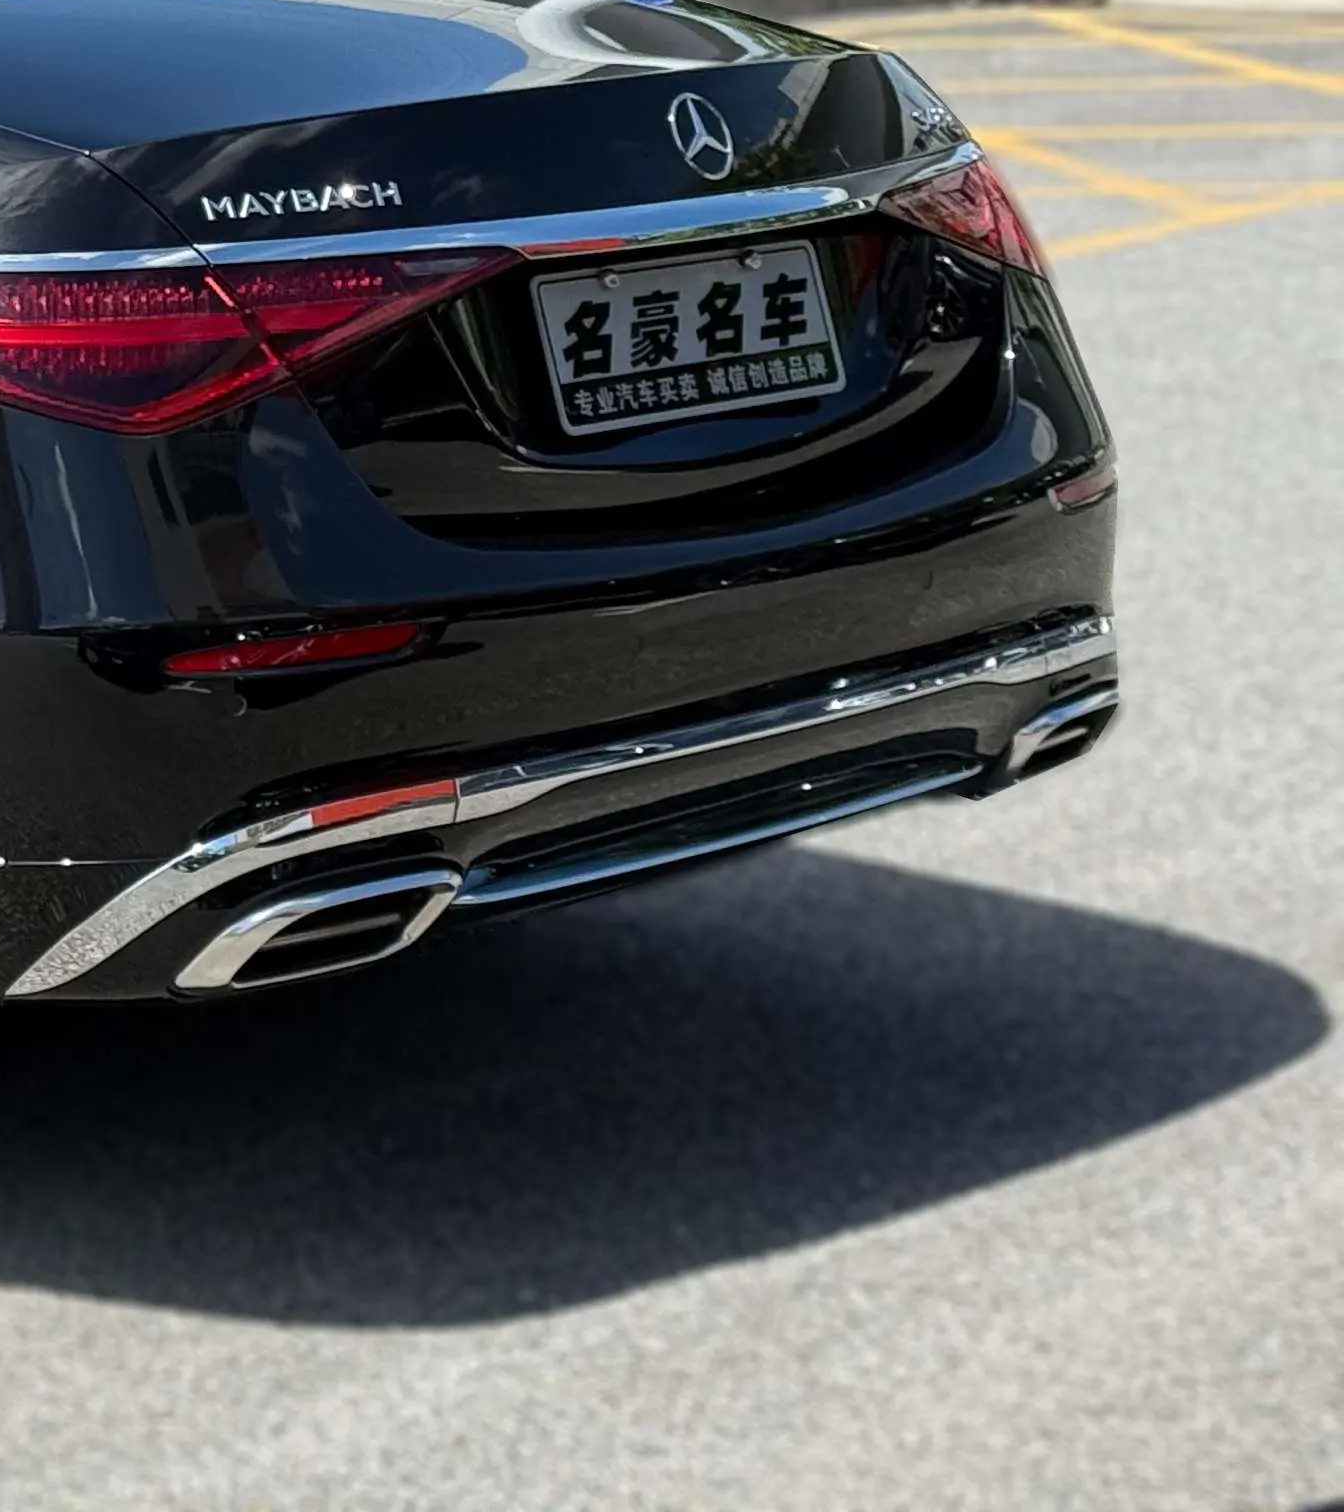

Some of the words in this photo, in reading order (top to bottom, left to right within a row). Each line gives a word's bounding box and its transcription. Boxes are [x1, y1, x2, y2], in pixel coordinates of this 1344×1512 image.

[200, 181, 403, 221] MAYBACH
[561, 272, 809, 379] 名豪名车
[574, 373, 700, 418] 专业汽车买卖
[707, 352, 829, 397] 诚信创造品牌
